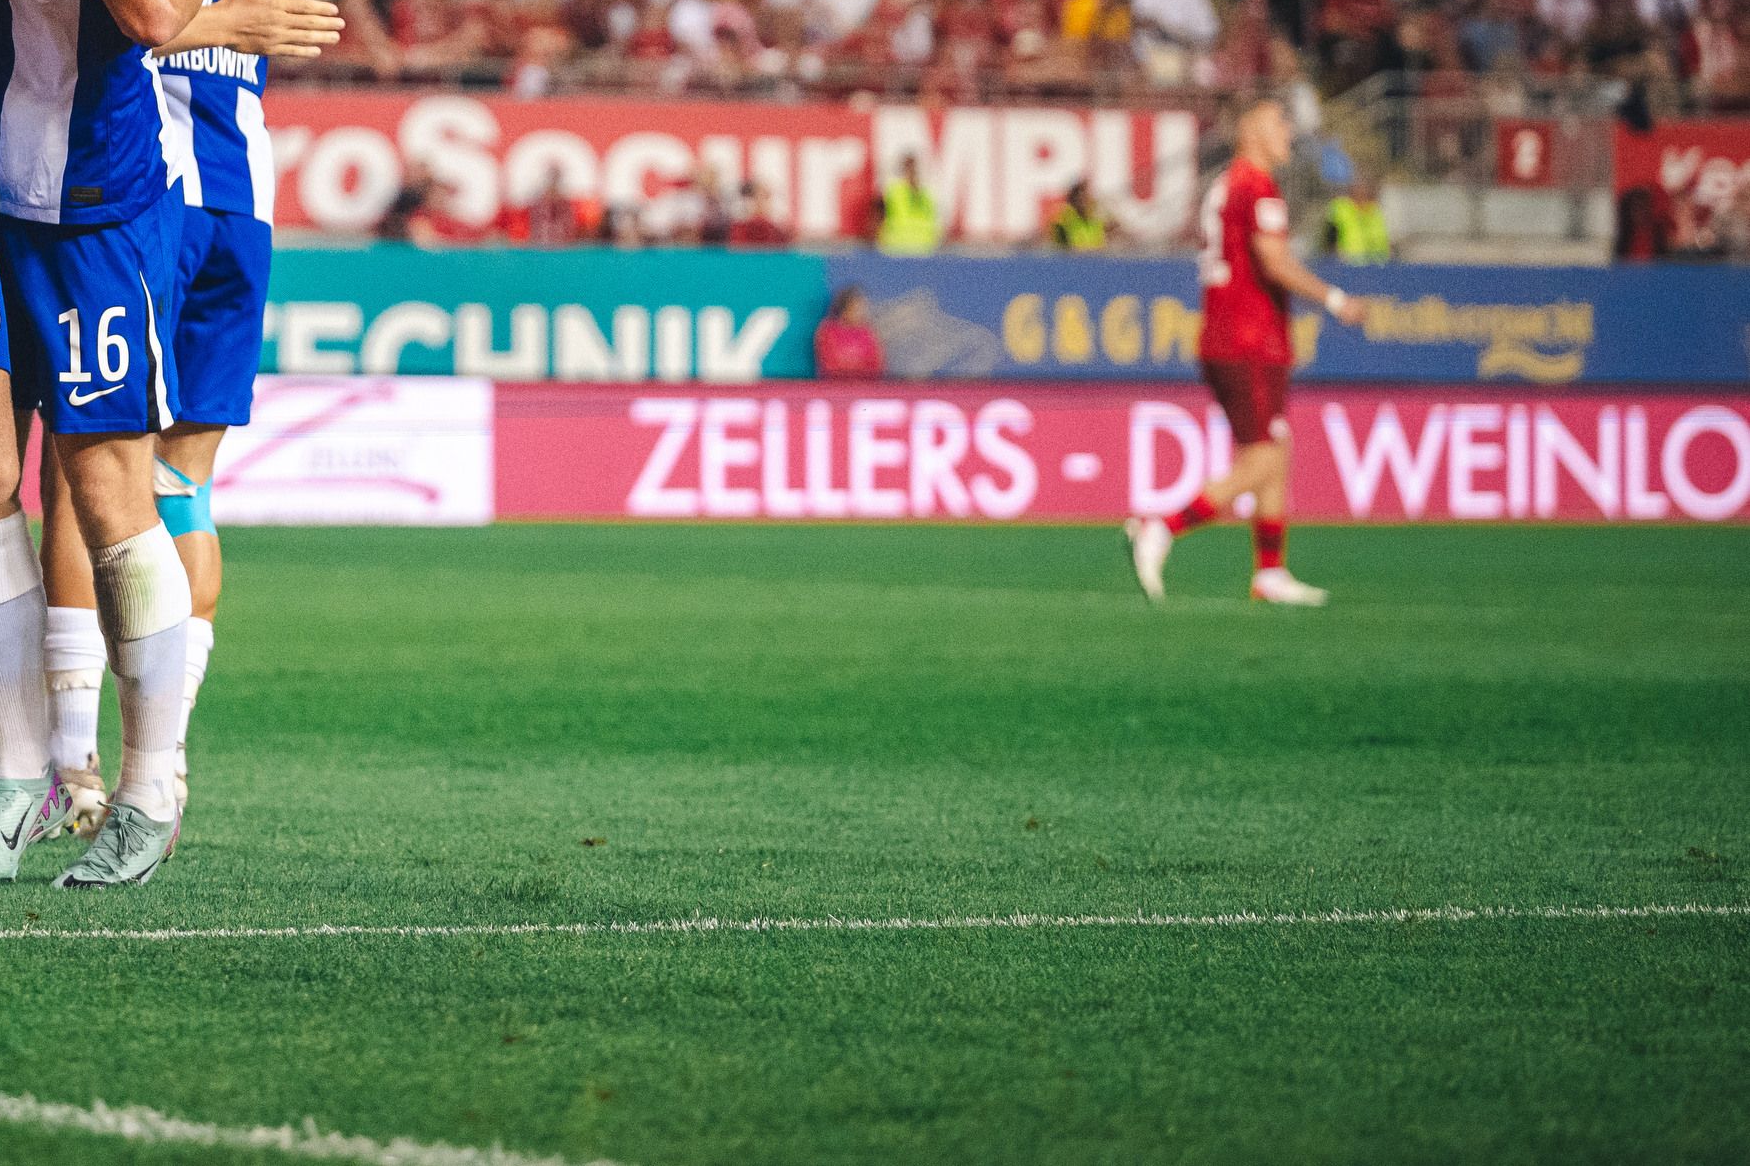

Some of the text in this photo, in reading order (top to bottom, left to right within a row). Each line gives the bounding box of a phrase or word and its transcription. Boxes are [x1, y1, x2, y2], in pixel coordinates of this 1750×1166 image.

[58, 306, 129, 383] 16
[626, 396, 1039, 520] ZELLERS
[1129, 400, 1250, 516] DI
